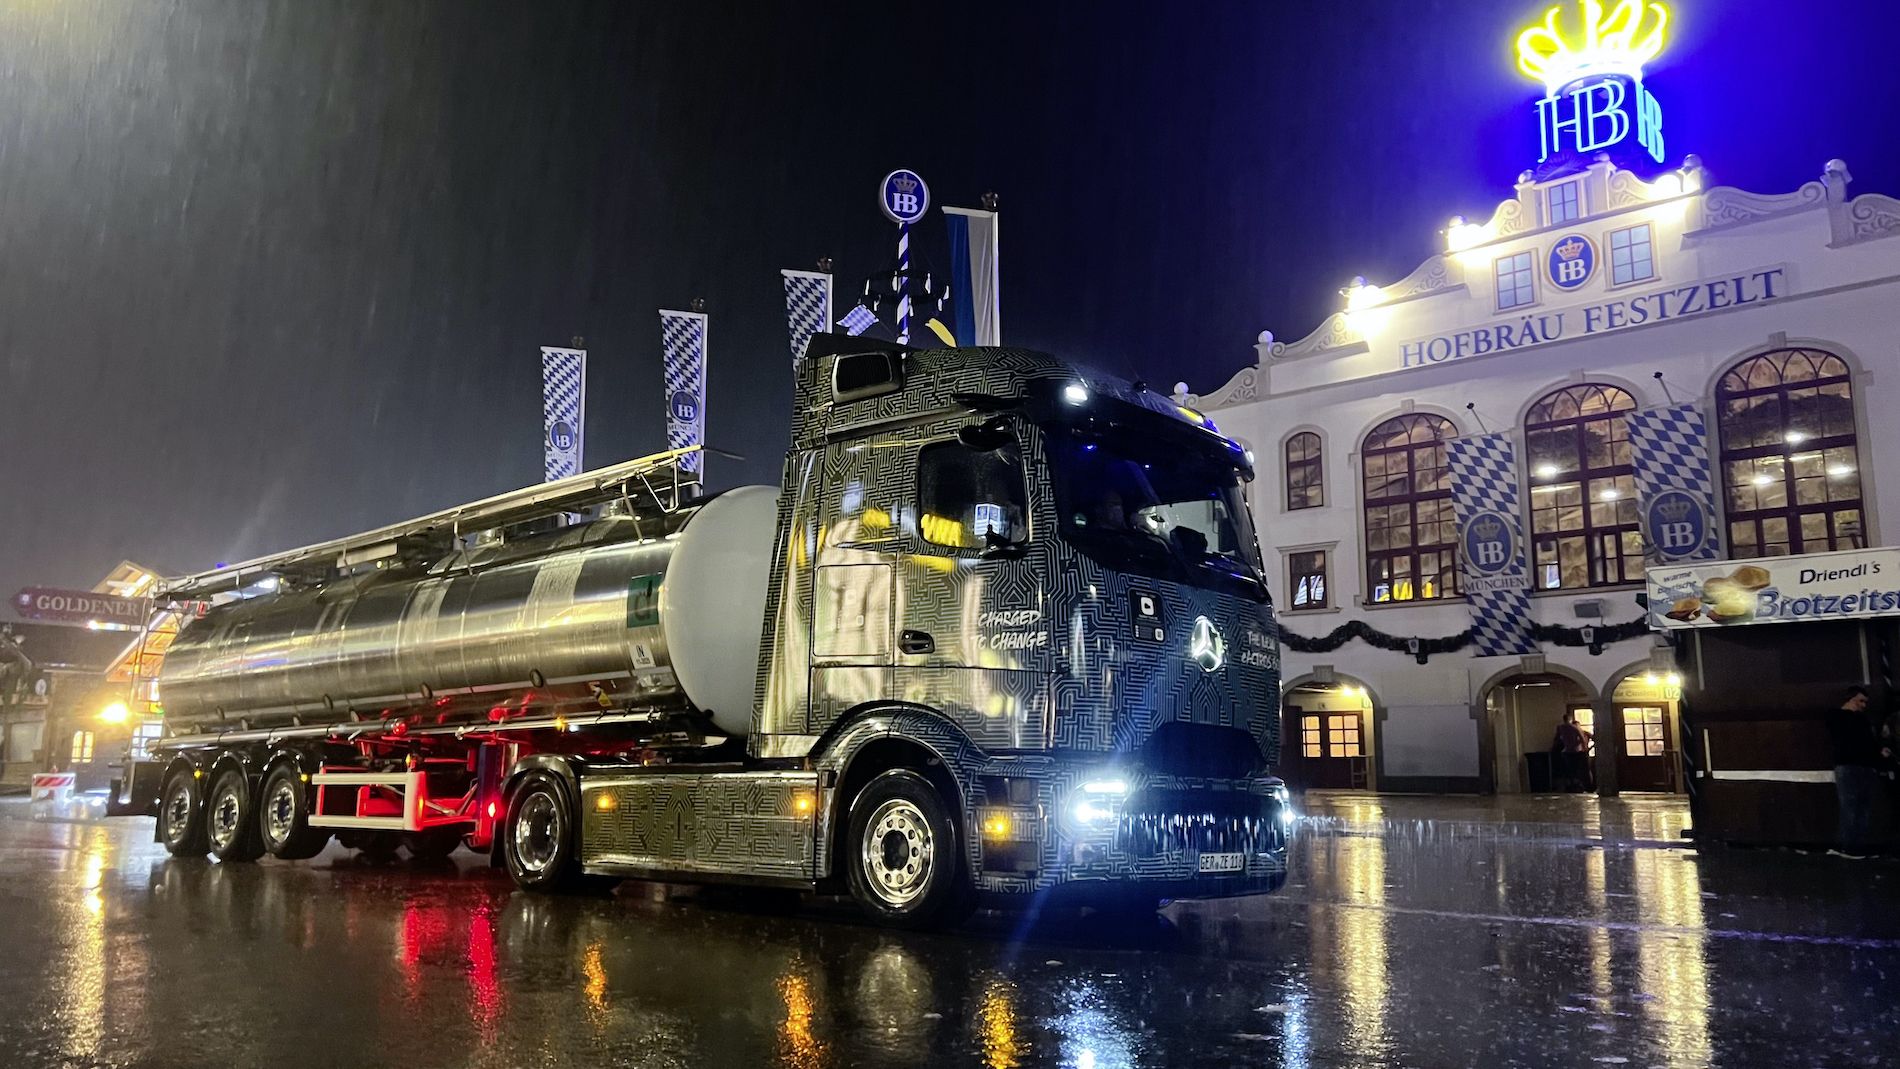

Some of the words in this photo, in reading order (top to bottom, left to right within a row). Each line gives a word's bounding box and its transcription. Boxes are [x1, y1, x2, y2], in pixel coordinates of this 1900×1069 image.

[1535, 79, 1630, 163] HB
[892, 192, 918, 213] HB
[1558, 259, 1586, 283] HB
[1400, 314, 1564, 368] HOFBRÄU
[1584, 268, 1783, 334] FESTZELT
[677, 404, 695, 419] HB
[1659, 521, 1696, 548] HB
[1476, 541, 1504, 566] HB
[1465, 577, 1529, 592] MÜNCHEN
[36, 594, 140, 617] GOLDENER
[978, 610, 1041, 628] CHARGED
[990, 631, 1047, 651] CHANGE
[1664, 686, 1681, 699] 02
[1200, 855, 1215, 870] GER
